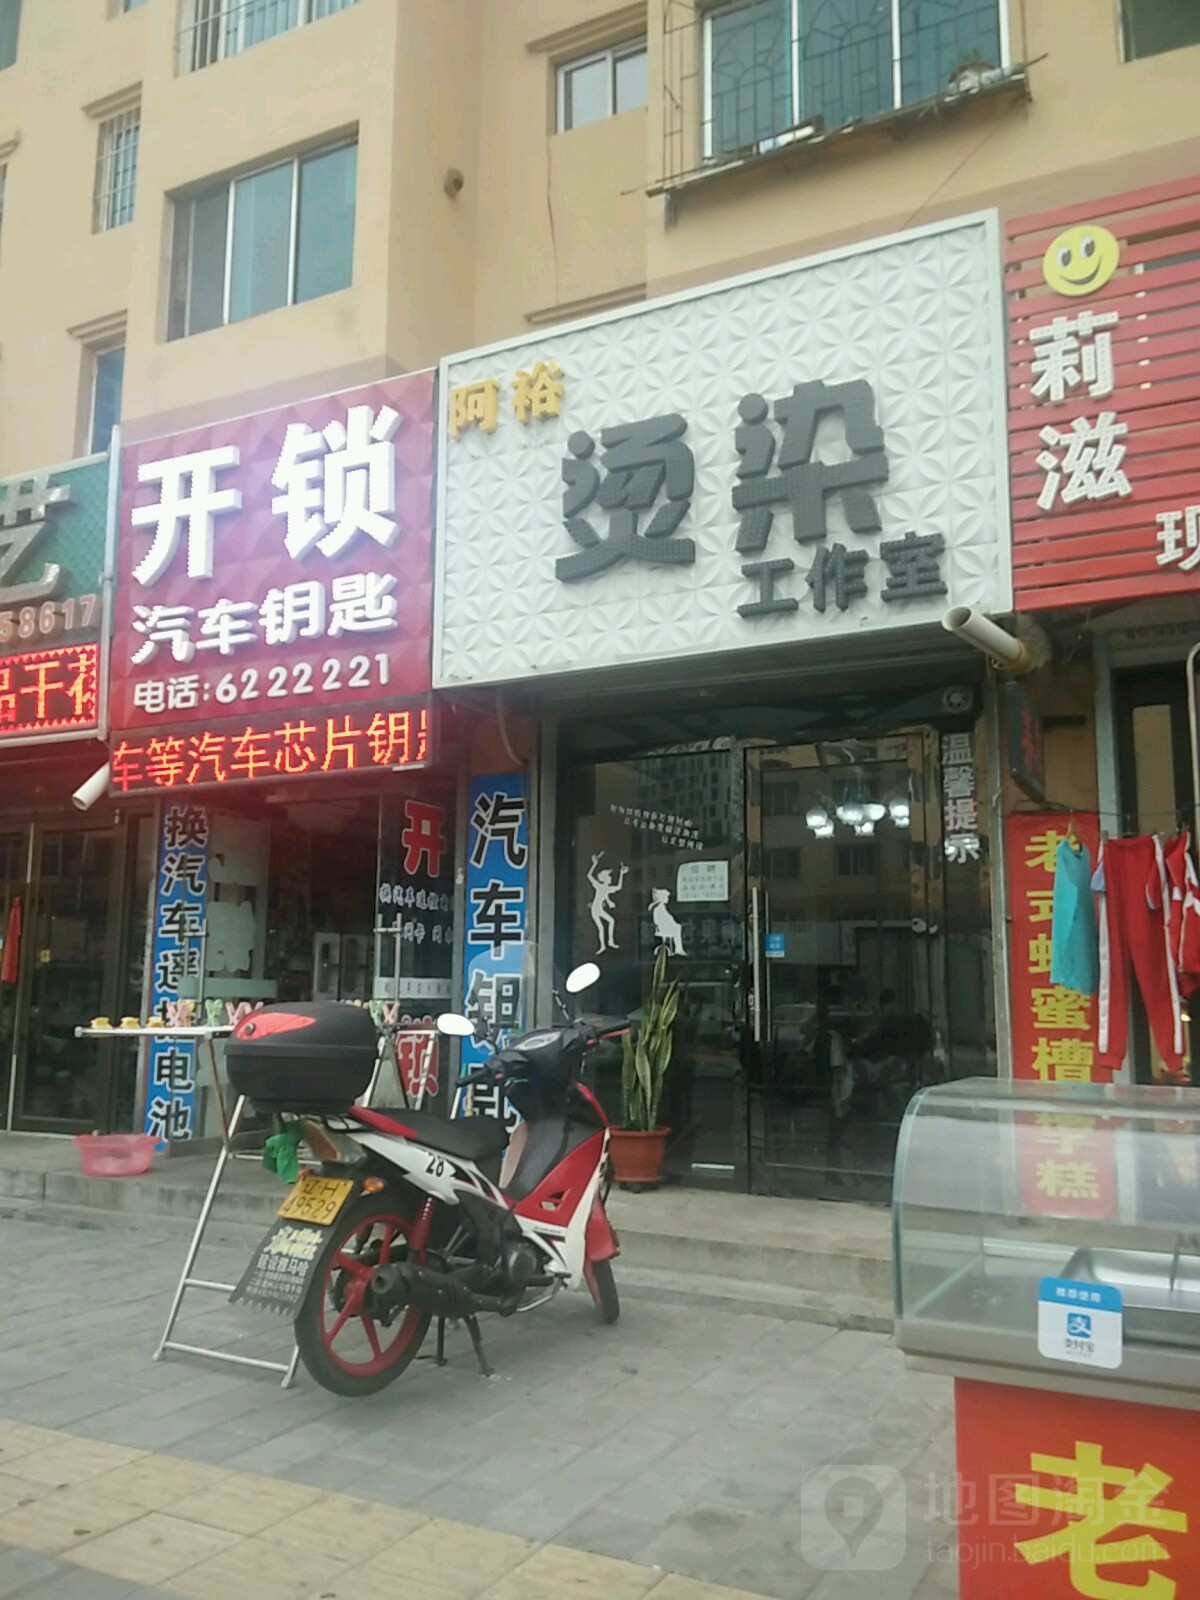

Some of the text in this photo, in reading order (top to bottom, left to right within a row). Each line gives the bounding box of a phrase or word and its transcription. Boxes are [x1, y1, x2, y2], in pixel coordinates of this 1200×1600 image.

[448, 360, 565, 440] 阿裕
[1028, 310, 1132, 511] 莉滋
[130, 404, 404, 587] 开锁
[555, 378, 889, 583] 烫染
[130, 572, 398, 666] 汽车钥匙
[736, 530, 948, 619] 工作室
[133, 654, 391, 714] 电话:6222221
[941, 733, 980, 864] 温馨提示
[147, 805, 208, 1143] 换汽车遥电池
[425, 1153, 444, 1177] 28
[1014, 1441, 1188, 1600] 老
